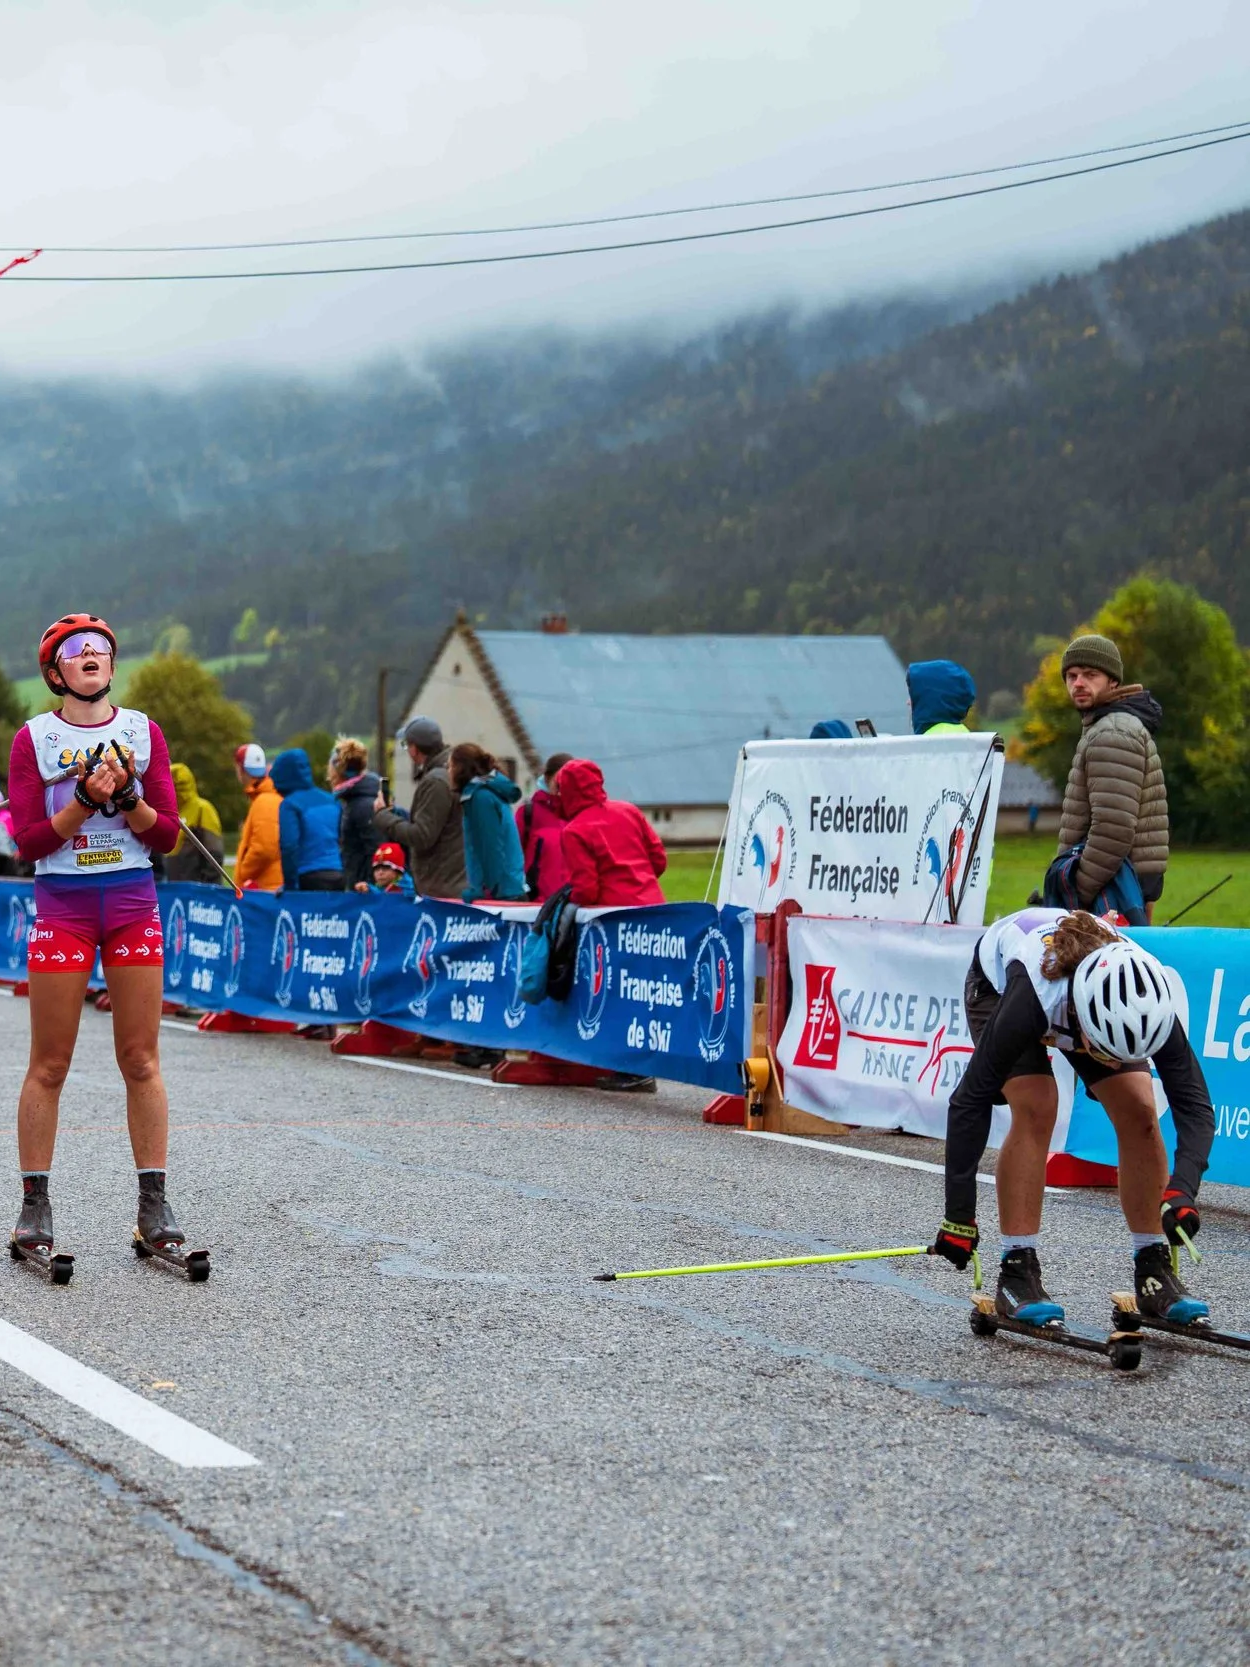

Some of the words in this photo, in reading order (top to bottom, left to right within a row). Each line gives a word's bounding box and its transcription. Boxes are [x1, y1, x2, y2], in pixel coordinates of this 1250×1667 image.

[810, 796, 908, 834] Fédération
[808, 854, 900, 902] Française
[301, 912, 349, 939] Fédération
[442, 916, 501, 943] Fédération
[617, 922, 686, 960] Fédération
[302, 949, 346, 981] Française
[440, 954, 495, 988] Française
[308, 985, 321, 1011] de
[321, 986, 338, 1012] Ski
[620, 968, 684, 1012] Française
[451, 993, 465, 1021] de
[466, 994, 485, 1024] Ski
[838, 988, 918, 1032] CAISSE
[923, 996, 969, 1038] D'E
[1203, 968, 1250, 1062] La
[627, 1016, 645, 1049] de
[648, 1019, 672, 1053] Ski
[1212, 1104, 1250, 1140] uve
